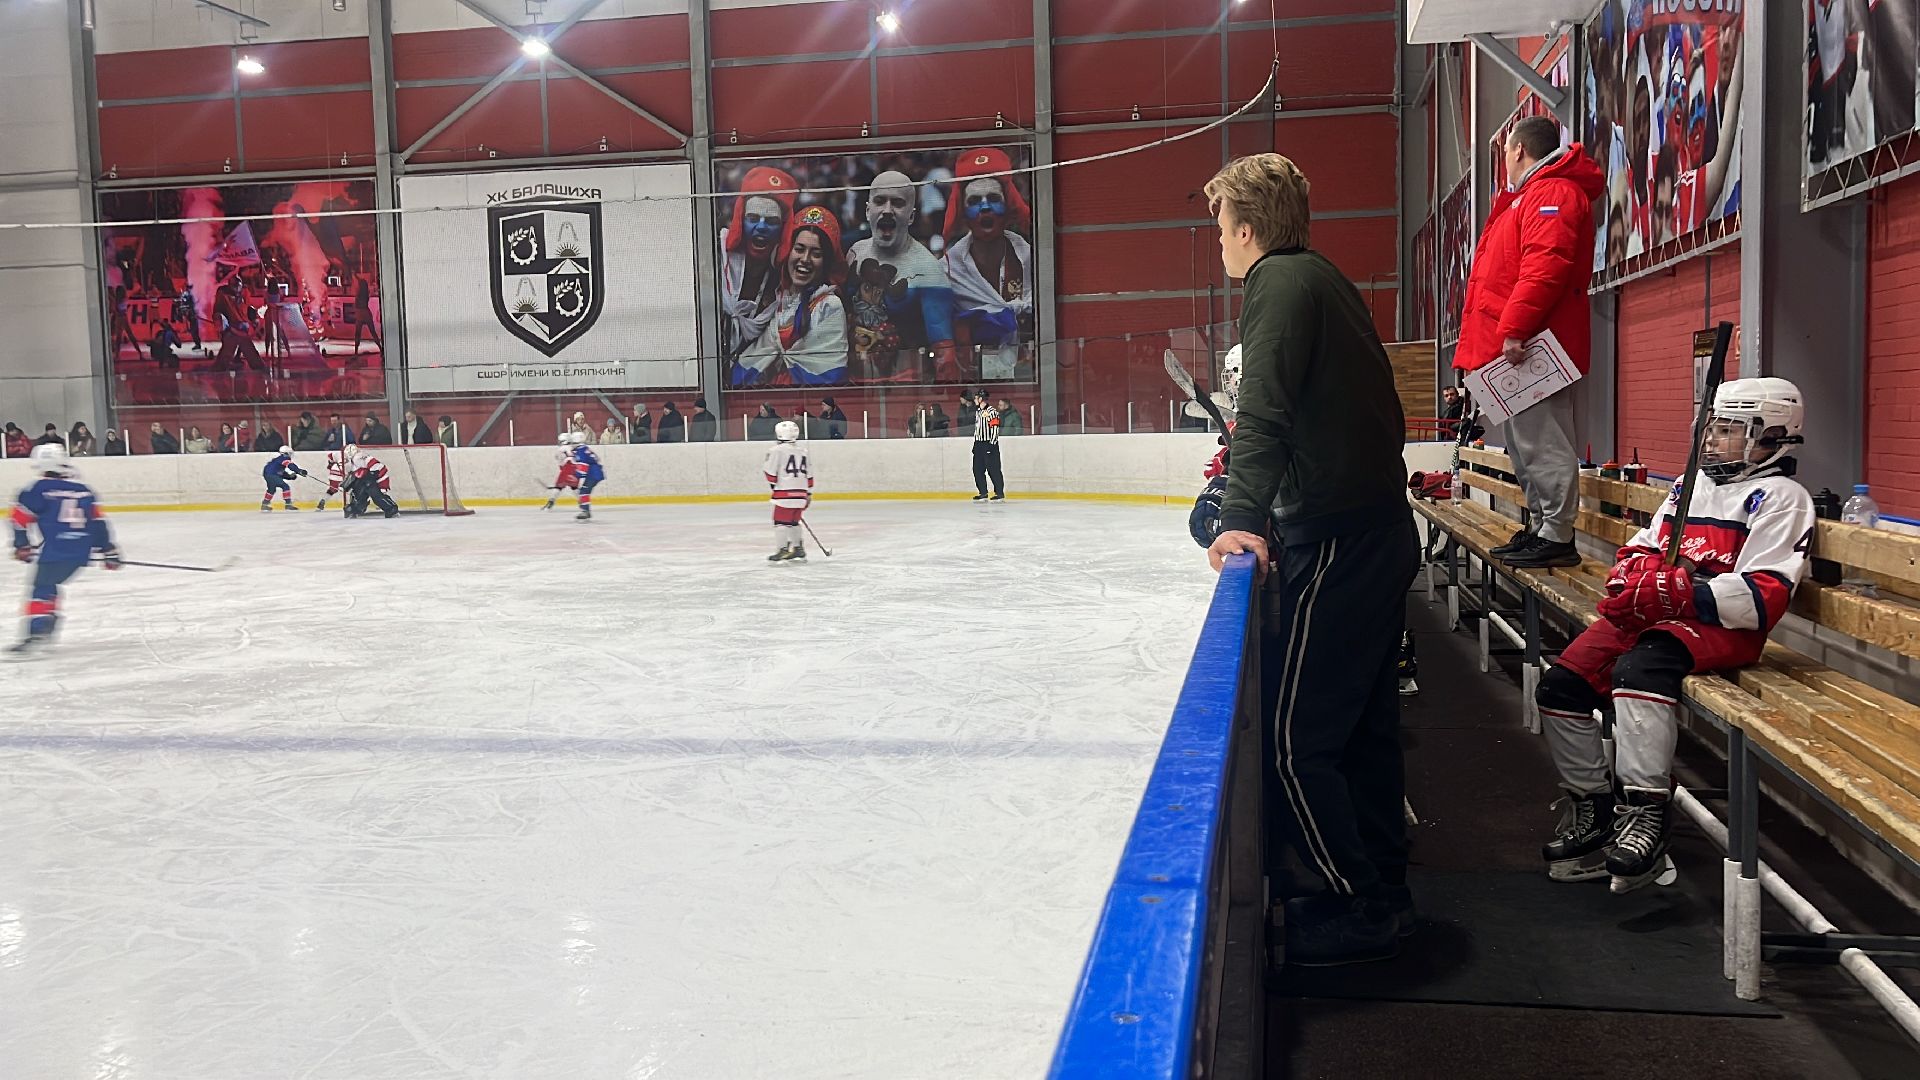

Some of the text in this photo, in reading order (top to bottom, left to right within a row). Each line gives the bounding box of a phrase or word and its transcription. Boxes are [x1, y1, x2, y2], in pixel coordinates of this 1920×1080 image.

[486, 183, 602, 204] ХК БАЛАШИХА
[477, 370, 508, 379] СШОР
[510, 369, 549, 378] ИМЕНИ
[785, 454, 807, 478] 44
